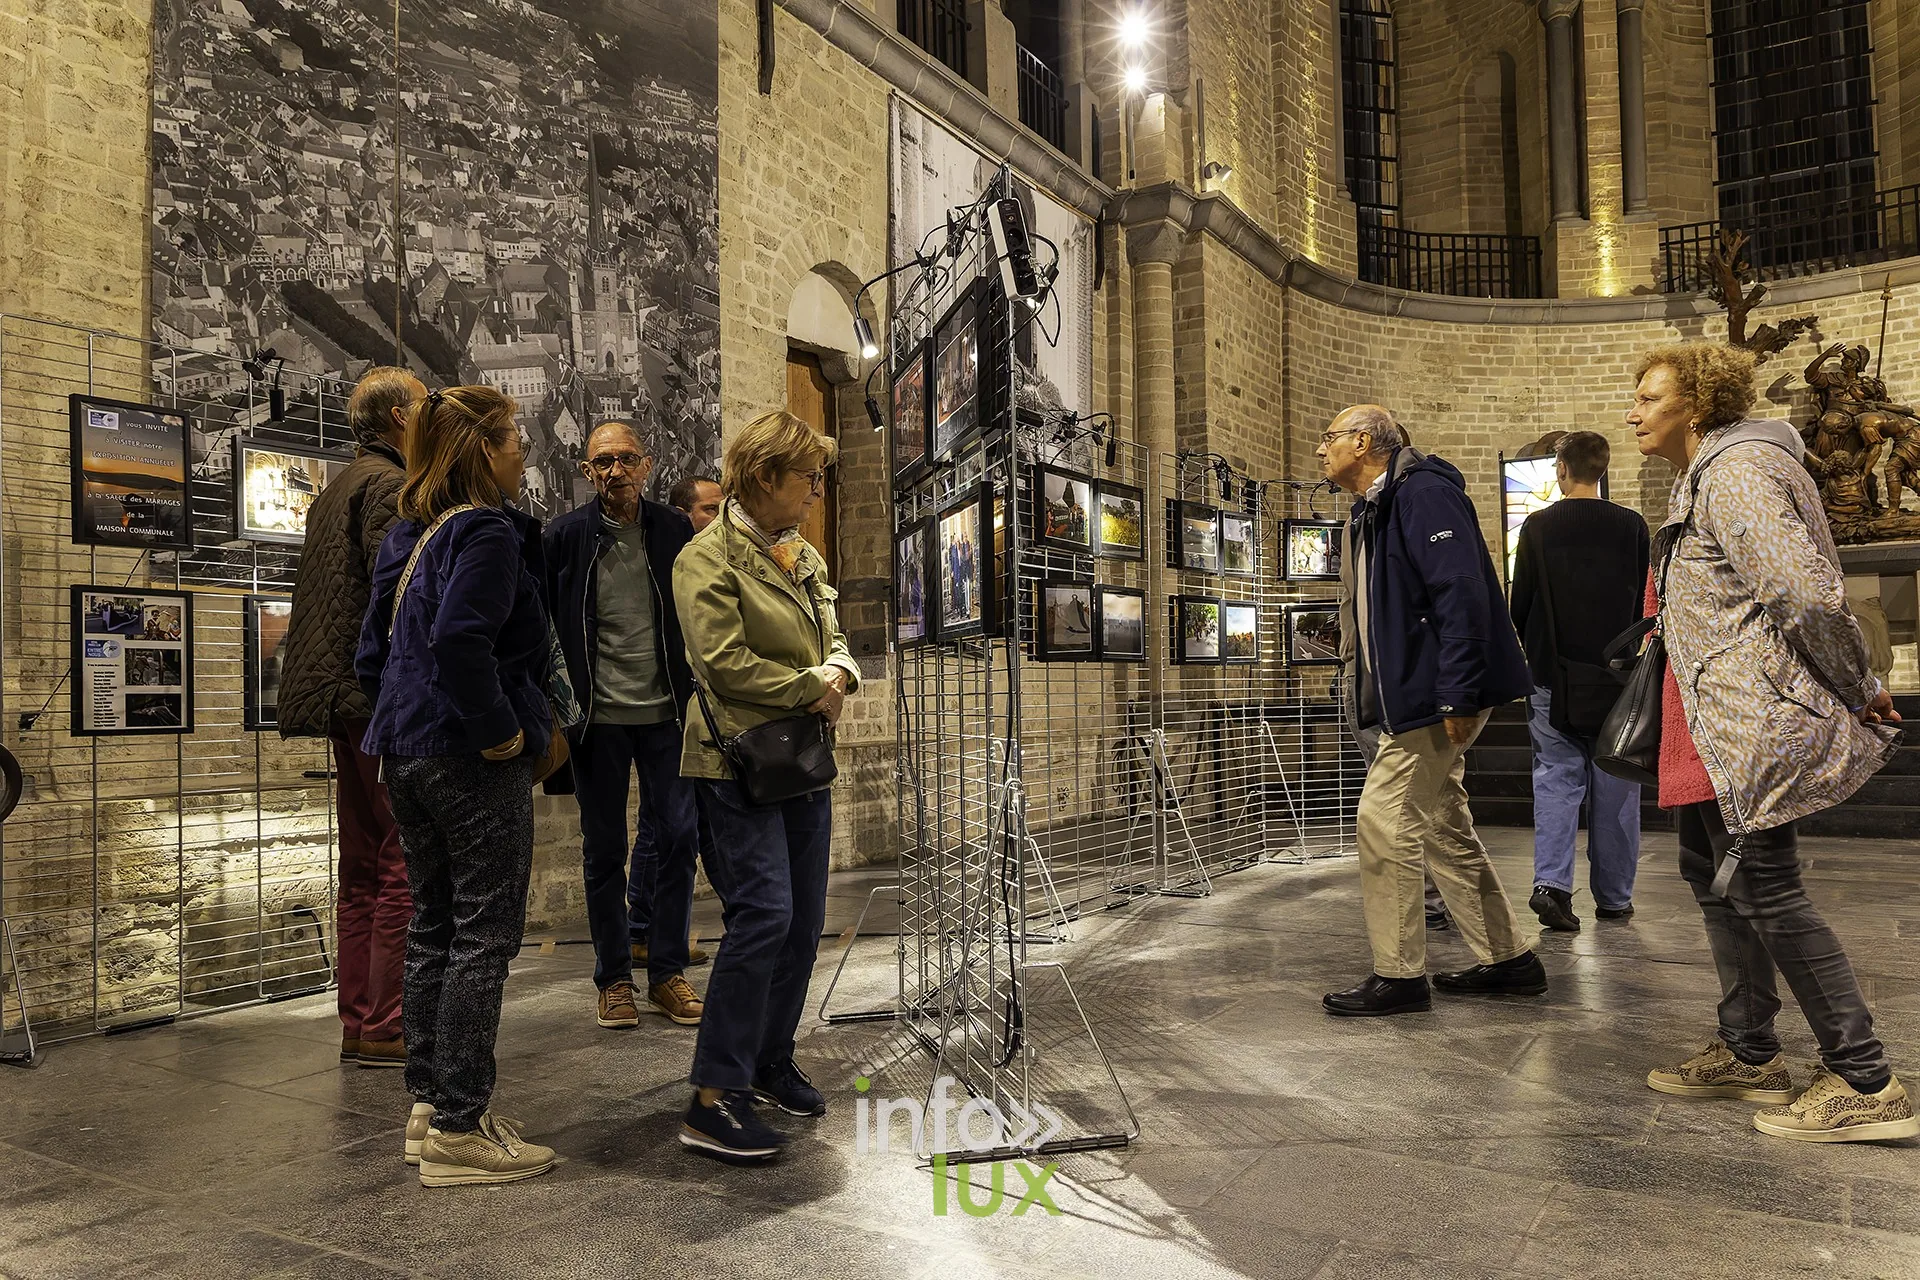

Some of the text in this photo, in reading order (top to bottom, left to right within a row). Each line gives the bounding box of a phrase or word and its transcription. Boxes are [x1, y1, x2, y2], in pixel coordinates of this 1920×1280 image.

[145, 424, 169, 433] INVITE
[113, 438, 140, 447] VISITER
[143, 443, 163, 451] notre
[92, 450, 176, 467] EXPOSITION ANNUELLE
[105, 493, 127, 502] SALLE
[129, 496, 143, 504] des
[145, 497, 181, 507] MARIAGES
[126, 511, 135, 519] de
[96, 524, 174, 537] MAISON COMMUNALE
